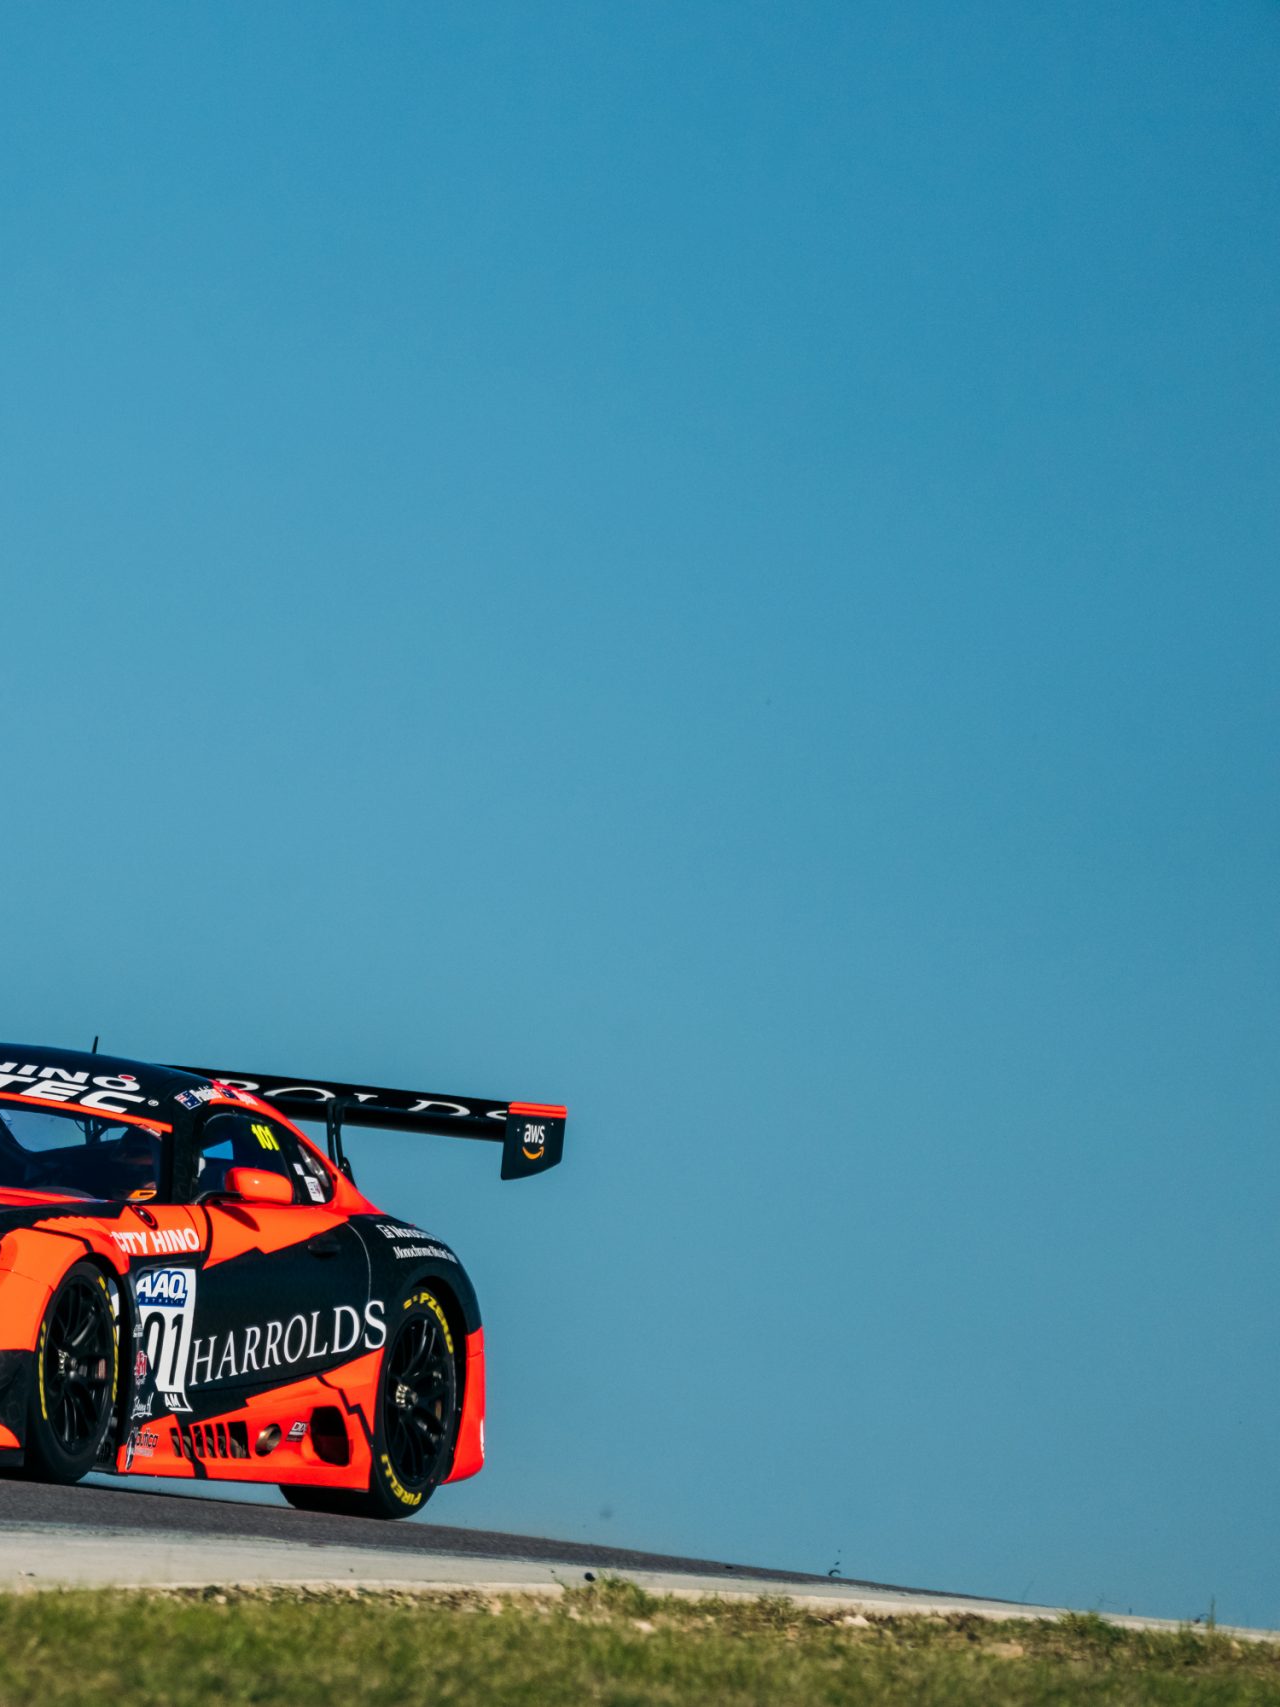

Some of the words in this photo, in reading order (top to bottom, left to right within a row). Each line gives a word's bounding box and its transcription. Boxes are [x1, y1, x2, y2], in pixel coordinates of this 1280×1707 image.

[250, 1124, 280, 1151] 101
[523, 1123, 545, 1144] aws
[111, 1230, 149, 1255] CITY
[150, 1227, 200, 1254] HINO
[189, 1299, 388, 1387] HARROLDS
